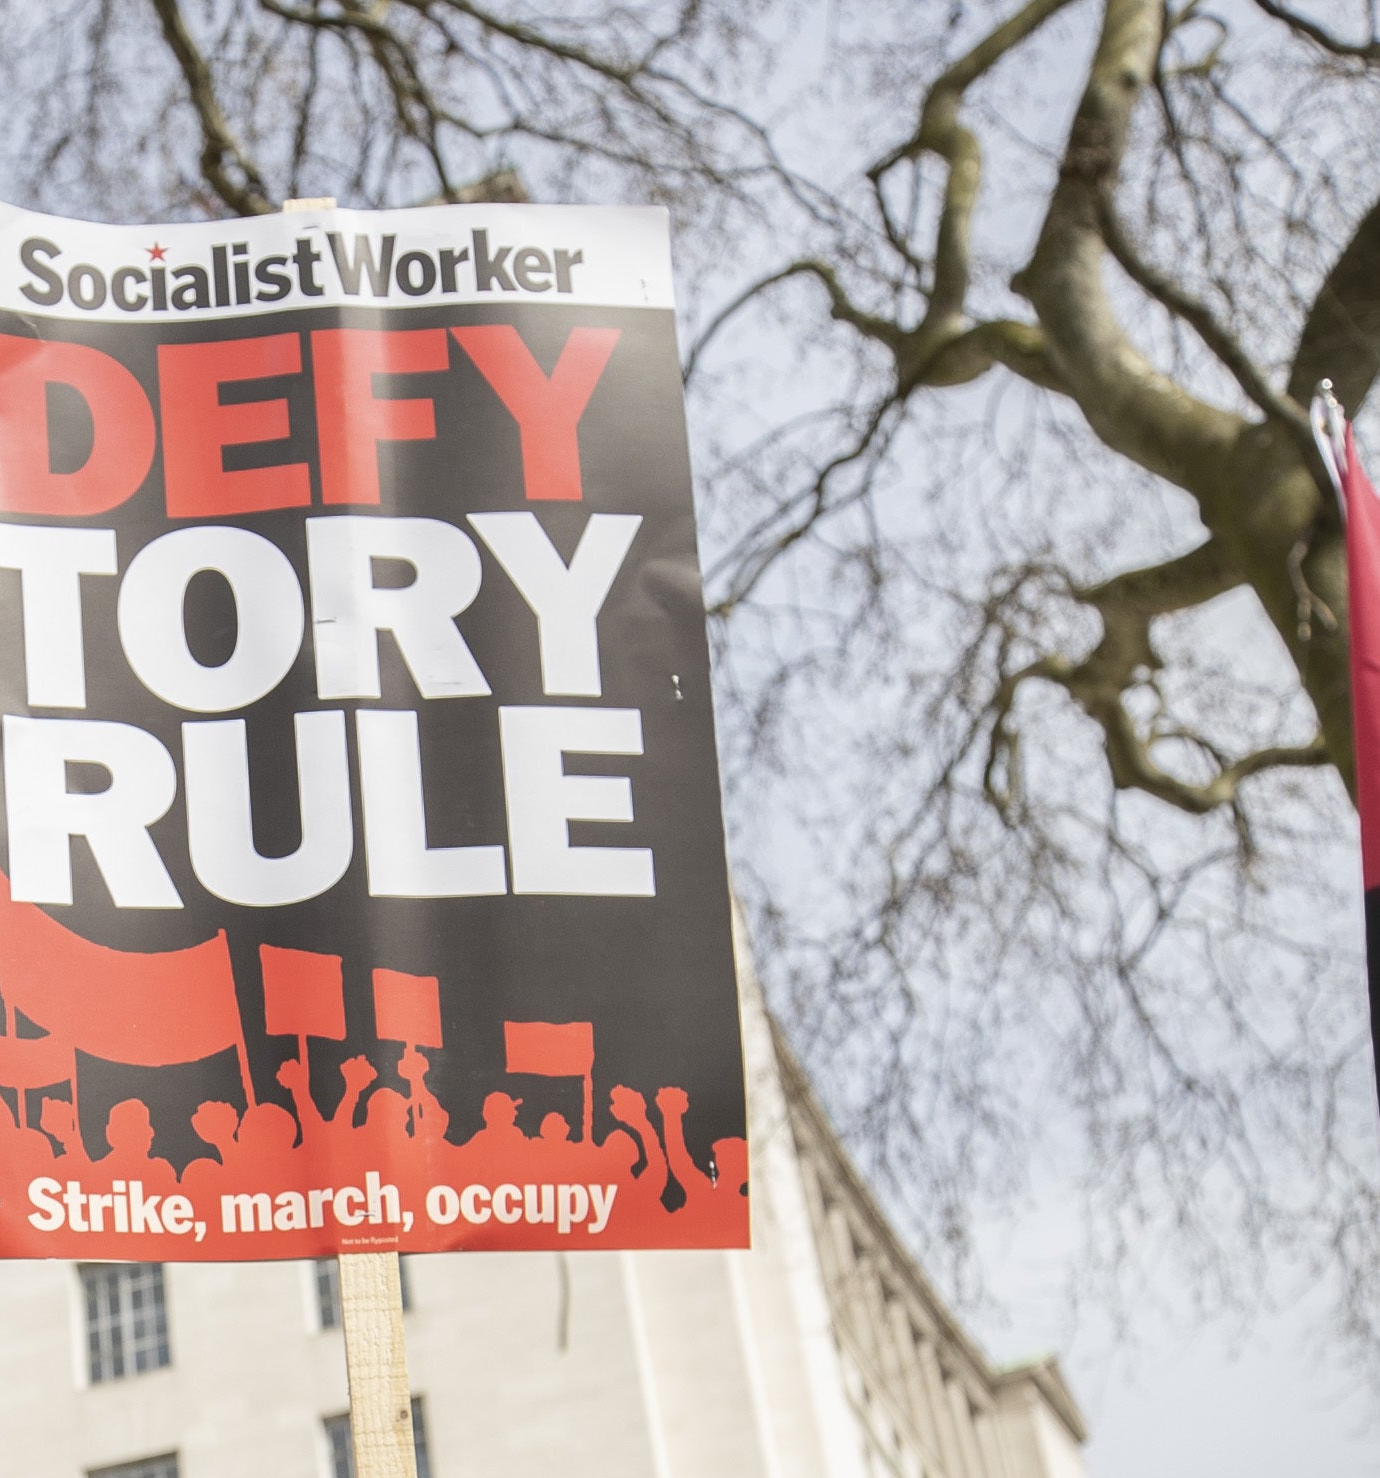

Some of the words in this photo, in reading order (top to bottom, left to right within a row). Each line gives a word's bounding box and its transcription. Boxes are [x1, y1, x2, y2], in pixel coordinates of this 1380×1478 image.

[2, 705, 656, 908] RULE
[27, 1177, 207, 1242] Strike,
[222, 1171, 414, 1231] march,
[426, 1183, 618, 1234] occupy
